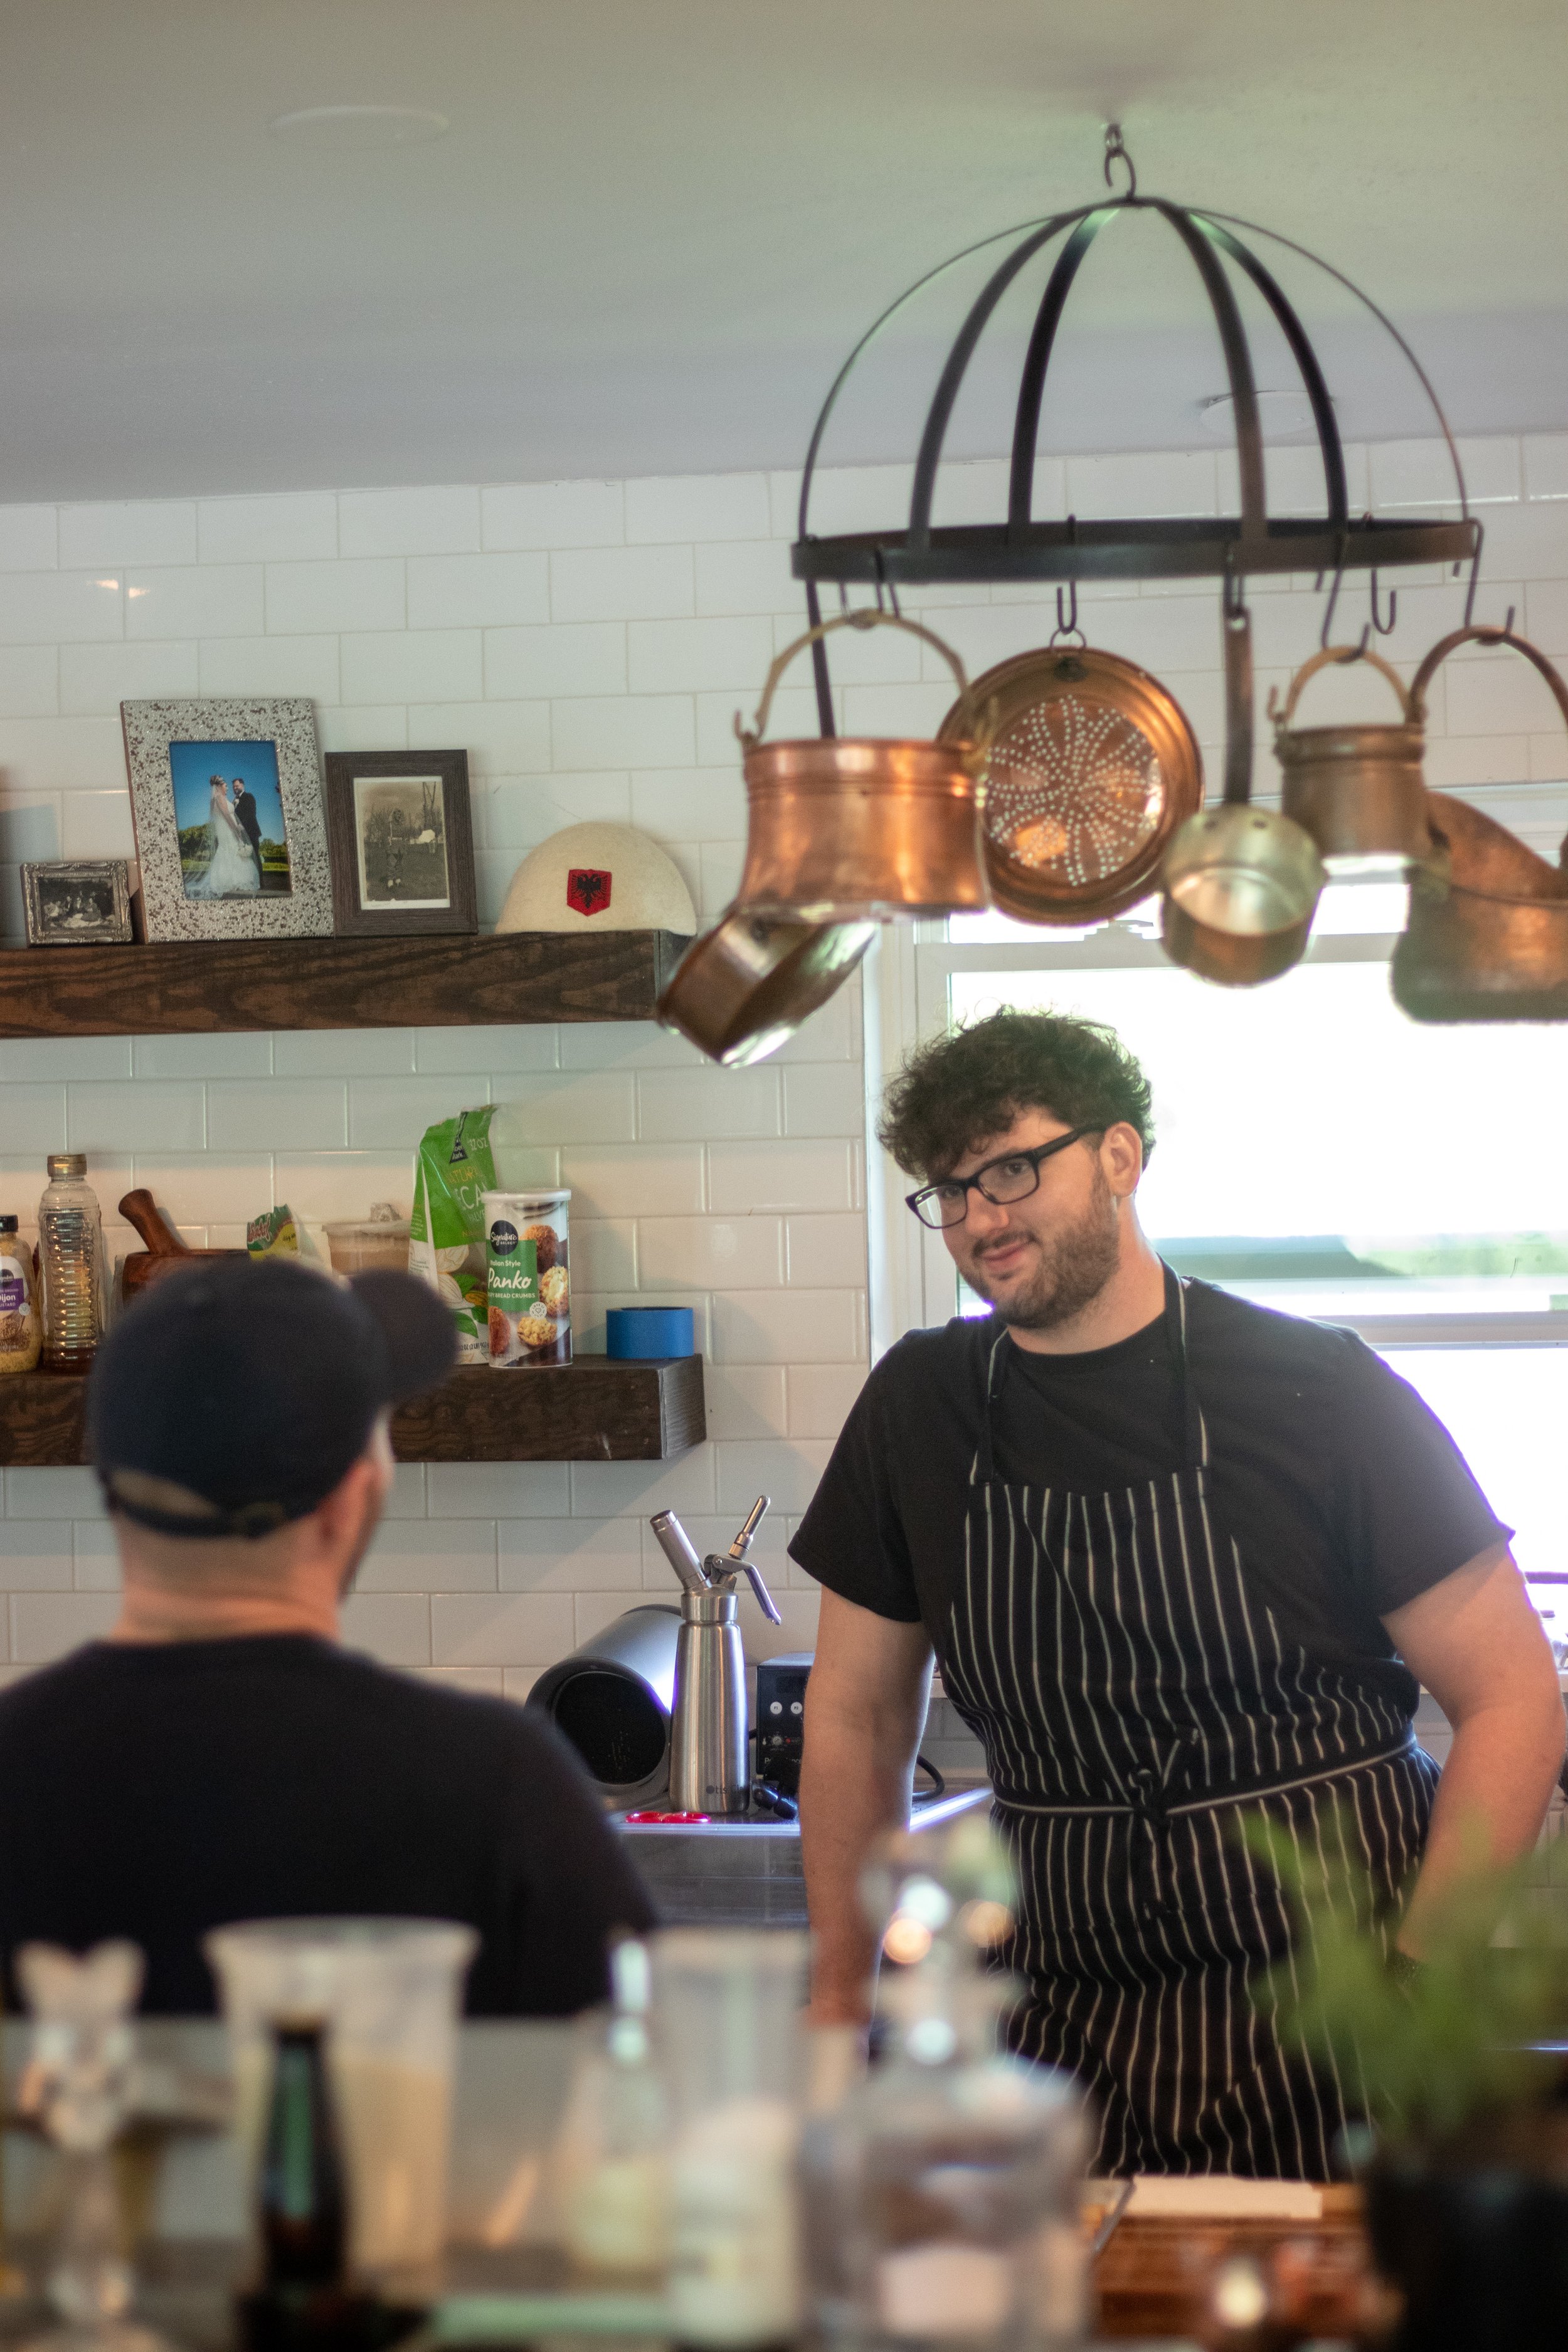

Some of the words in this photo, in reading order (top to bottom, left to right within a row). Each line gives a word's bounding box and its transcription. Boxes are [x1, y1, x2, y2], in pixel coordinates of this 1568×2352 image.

[491, 1232, 517, 1246] Signature
[505, 1259, 521, 1268] Style
[488, 1268, 532, 1289] Panko
